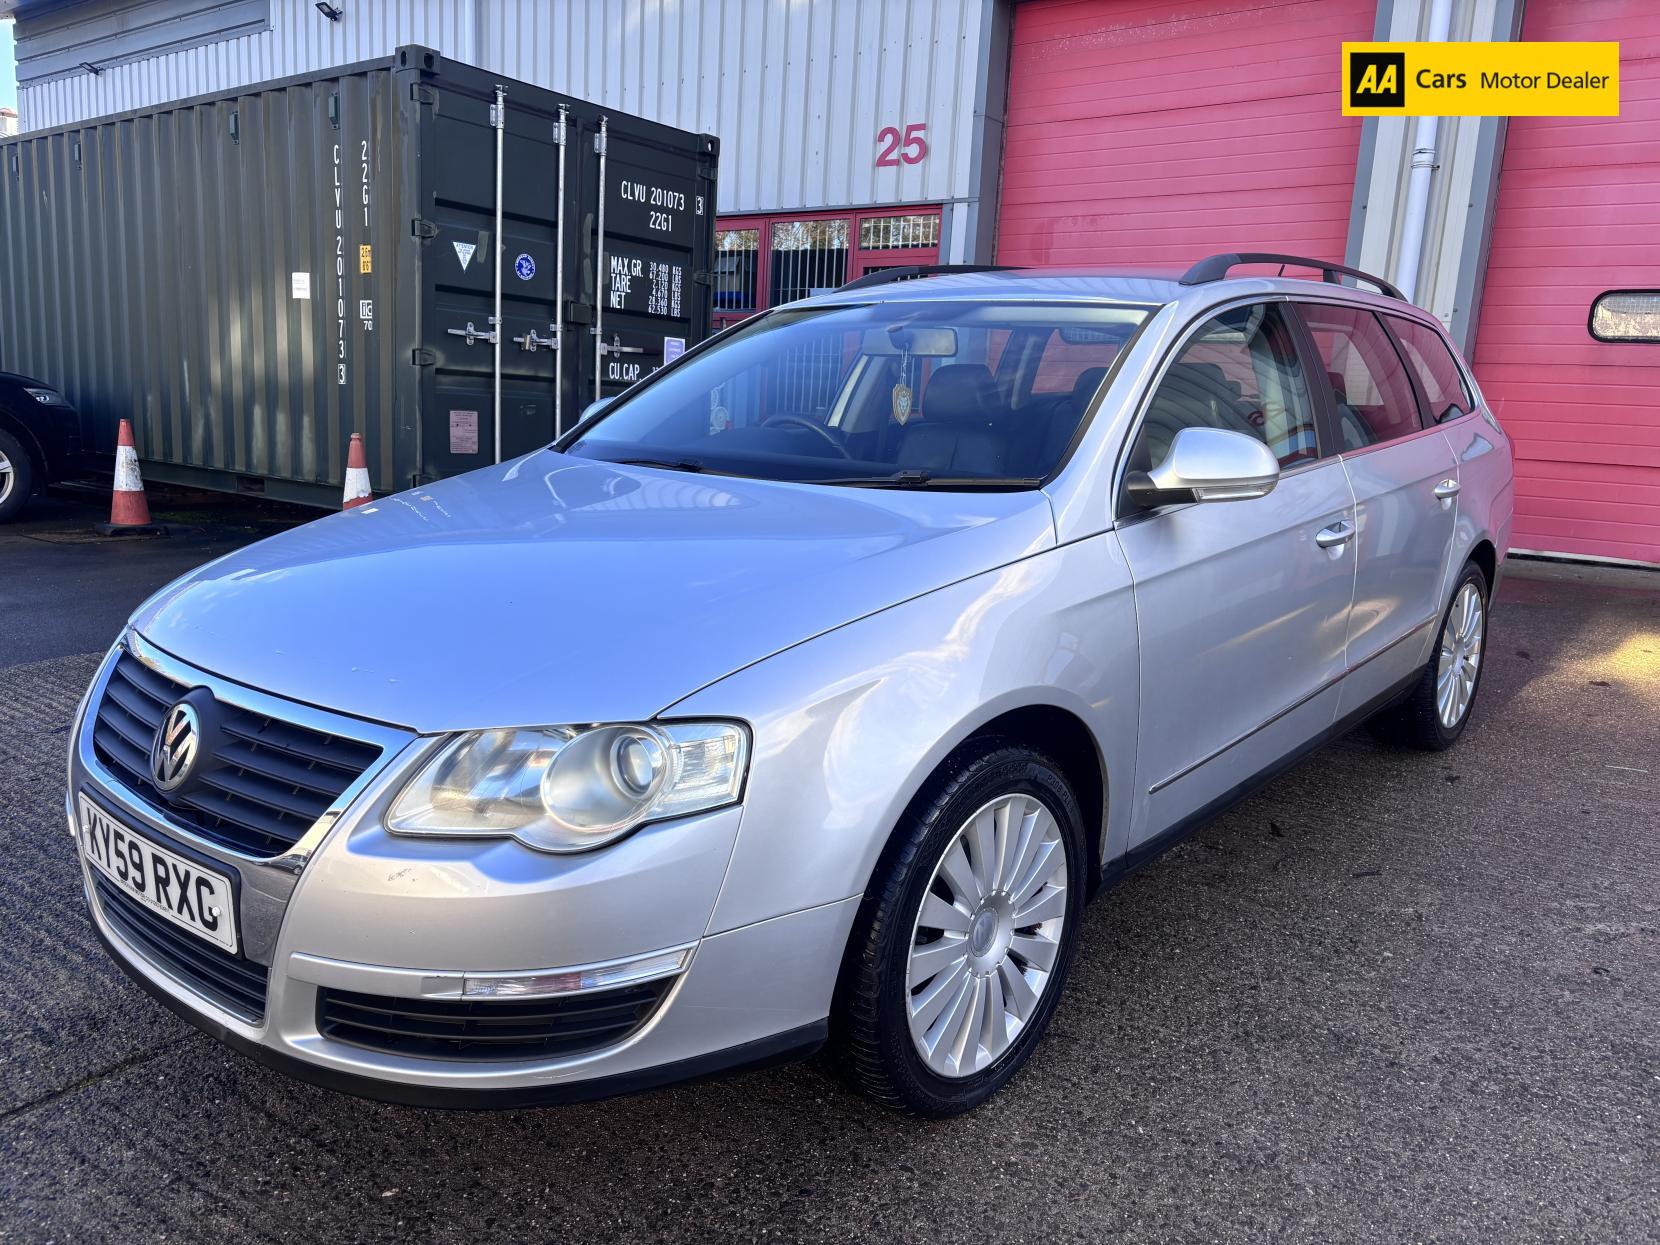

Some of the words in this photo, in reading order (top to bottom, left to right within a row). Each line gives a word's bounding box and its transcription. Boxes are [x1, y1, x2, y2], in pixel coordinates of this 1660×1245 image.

[875, 123, 927, 167] 25
[333, 144, 342, 229] CLVU
[361, 140, 369, 227] 22G1
[621, 180, 646, 203] CLVU
[650, 187, 685, 211] 201073
[696, 196, 703, 215] 3
[649, 211, 672, 232] 22G1
[672, 265, 682, 276] KGS
[672, 274, 681, 284] LBS
[610, 273, 632, 293] TARE
[671, 283, 681, 293] KGS
[336, 236, 345, 359] 201073
[610, 290, 626, 310] NET
[671, 300, 681, 310] KGS
[671, 291, 681, 301] LBS
[670, 308, 681, 318] LBS
[337, 364, 346, 385] 3
[86, 806, 147, 893] KY59
[151, 851, 218, 932] RXG
